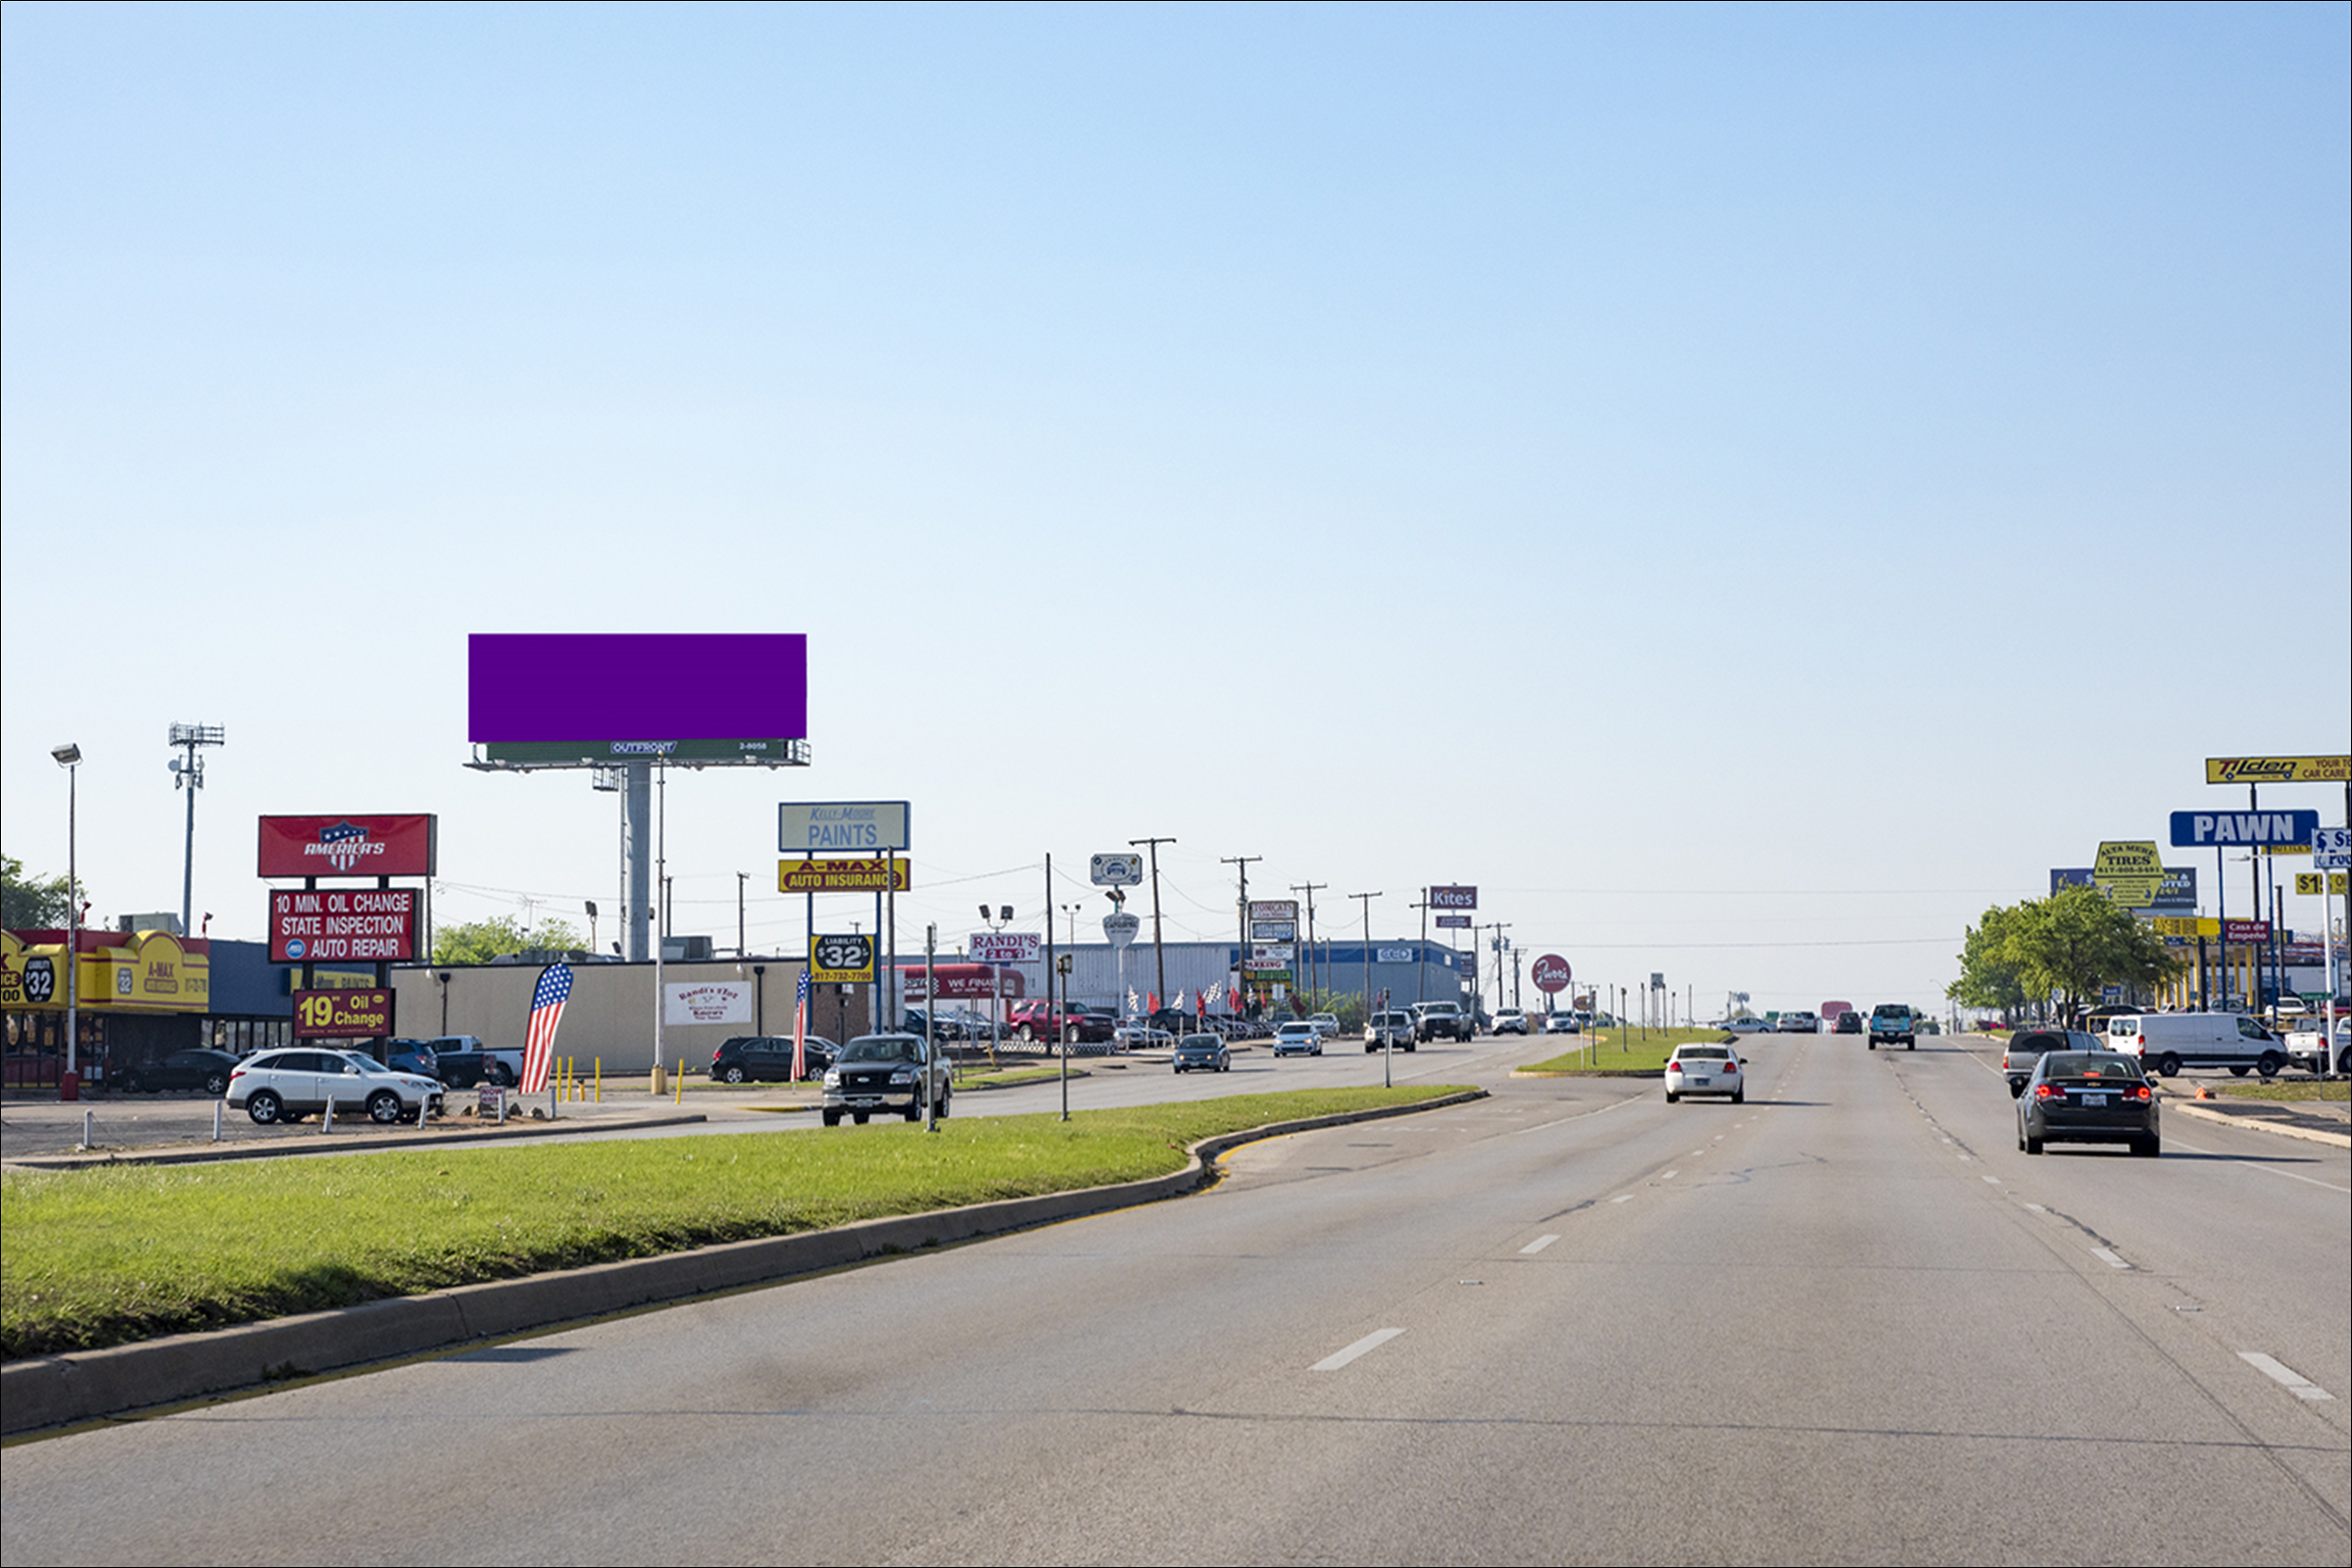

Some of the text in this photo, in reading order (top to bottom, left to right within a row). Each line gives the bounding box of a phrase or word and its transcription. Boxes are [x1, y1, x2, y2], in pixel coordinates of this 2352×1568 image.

[612, 742, 672, 753] OUTFRONT
[2315, 759, 2341, 768] YOUR
[2302, 768, 2321, 779] CAR
[2323, 768, 2347, 778] CARE
[808, 823, 878, 847] PAINTS
[2193, 813, 2294, 843] PAWN
[304, 842, 385, 856] AMERICA'S
[2100, 844, 2156, 858] ALTA MERE
[798, 860, 886, 871] A-MAX
[2107, 856, 2151, 866] TIRES
[789, 873, 823, 888] AUTO
[276, 894, 410, 913] 10 MIN. OIL CHANGE
[1434, 891, 1473, 906] Kite's
[281, 916, 404, 935] STATE INSPECTION
[311, 939, 348, 957] AUTO
[352, 938, 399, 956] REPAIR
[972, 935, 1039, 949] RANDI'S
[988, 949, 998, 959] 2
[1000, 949, 1012, 958] to
[948, 978, 965, 988] WE
[350, 995, 369, 1009] Oil
[334, 1010, 385, 1028] Change
